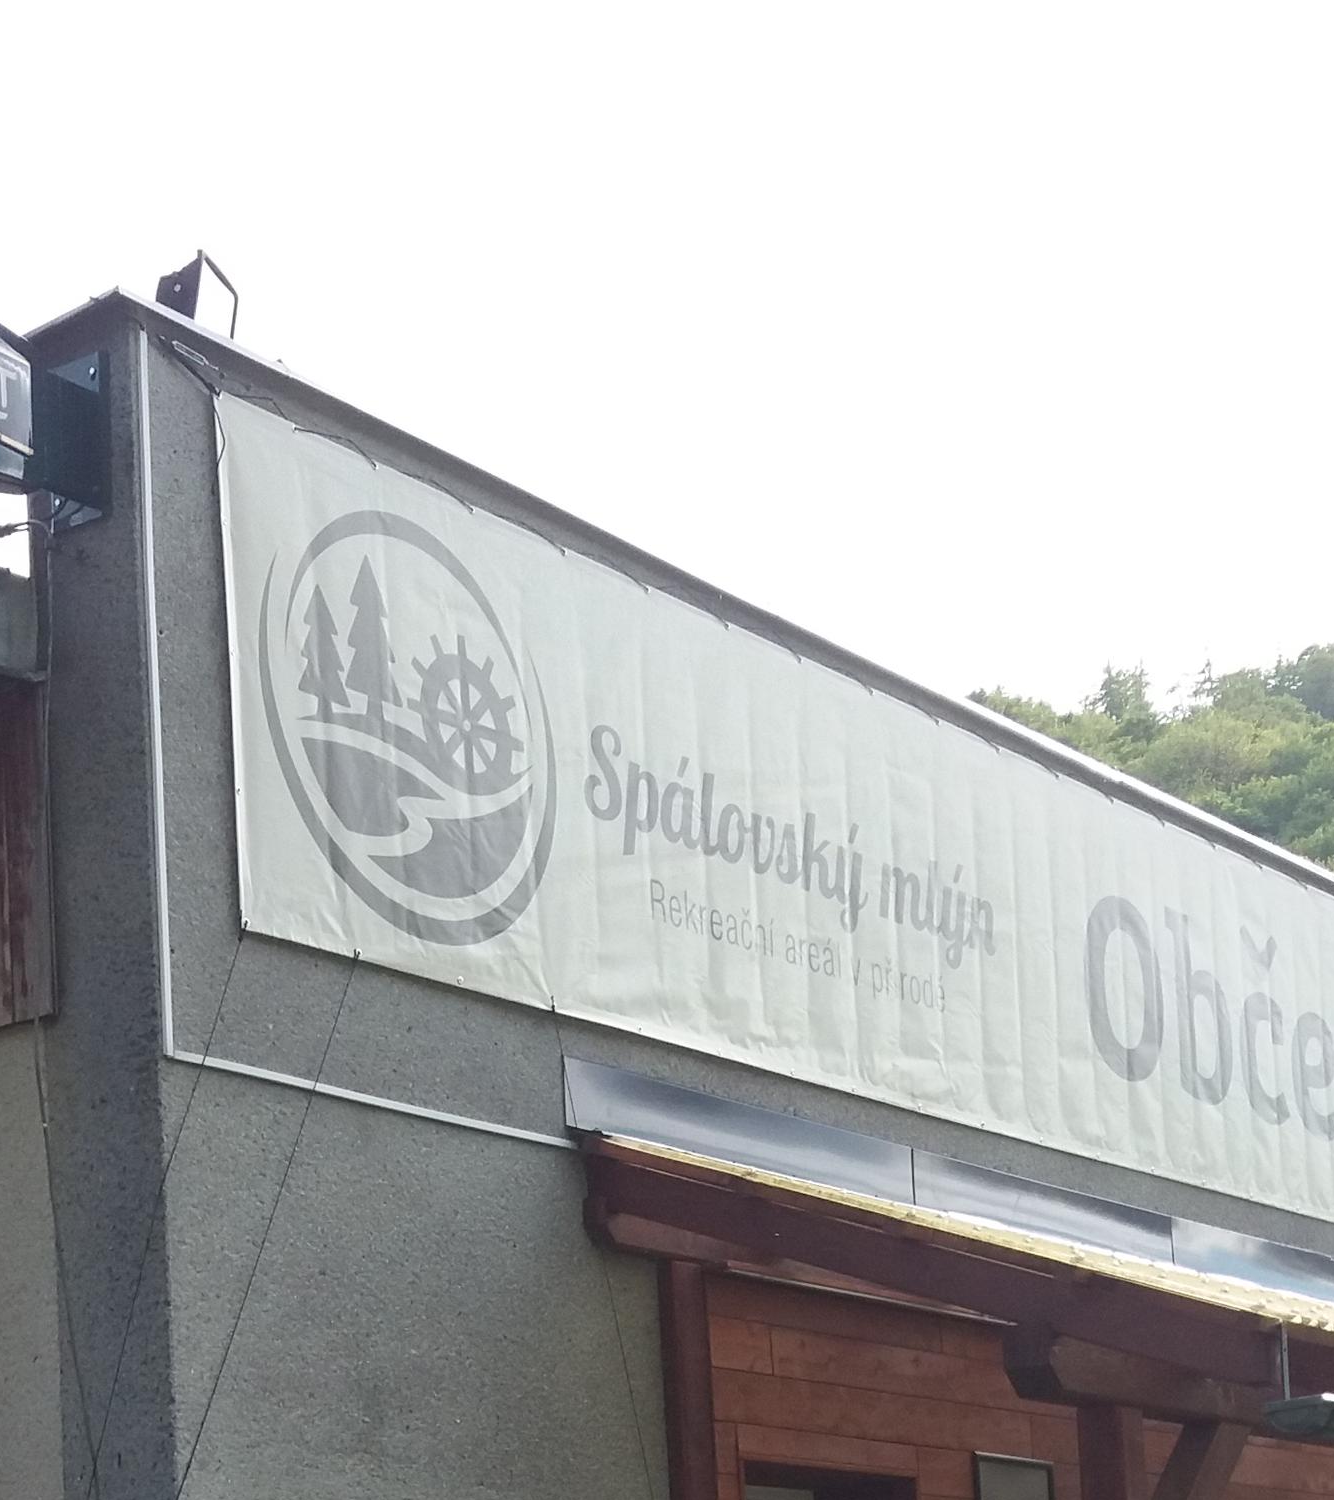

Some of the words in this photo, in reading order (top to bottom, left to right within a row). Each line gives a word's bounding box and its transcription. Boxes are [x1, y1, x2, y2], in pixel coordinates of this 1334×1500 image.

[583, 724, 869, 934] Spálovský
[879, 860, 997, 970] mlýn
[649, 878, 775, 958] Rekreační
[785, 936, 842, 980] areál
